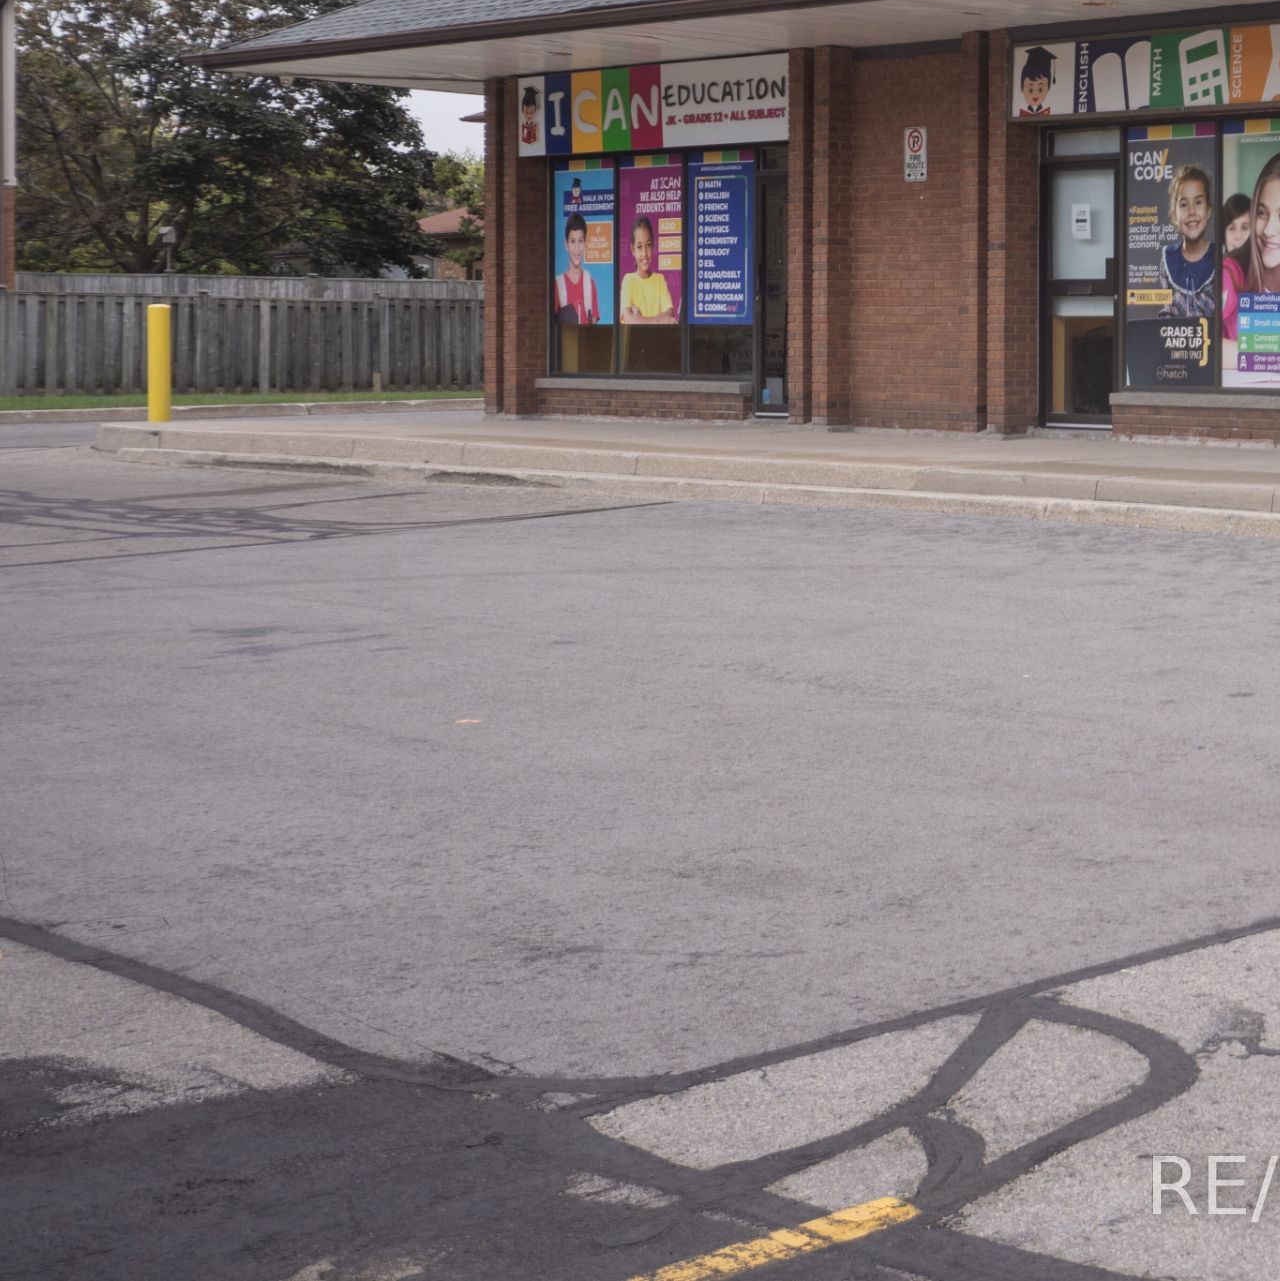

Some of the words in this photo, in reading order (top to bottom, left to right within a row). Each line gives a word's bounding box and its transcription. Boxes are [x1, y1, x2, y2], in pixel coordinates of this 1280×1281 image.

[1232, 32, 1243, 98] SCIENCE
[1152, 48, 1163, 96] MATH
[1079, 43, 1090, 113] ENGLISH
[662, 75, 786, 107] EDUCATION
[666, 115, 677, 126] JK
[683, 113, 712, 125] GRADE
[713, 111, 723, 122] 12
[730, 110, 746, 121] ALL
[747, 107, 786, 120] SUBJECT
[1134, 165, 1173, 180] CODE
[650, 178, 659, 190] AT
[660, 176, 681, 189] ICAN
[705, 180, 721, 188] MATH
[582, 194, 597, 202] WALK
[604, 193, 614, 201] FOR
[639, 191, 649, 202] WE
[650, 191, 665, 201] ALSO
[666, 190, 681, 200] HELP
[705, 192, 730, 200] ENGLISH
[564, 203, 578, 212] FREE
[579, 203, 614, 211] ASSESSMENT
[636, 202, 665, 213] STUDENTS
[665, 202, 681, 212] WITH
[705, 214, 730, 222] SCIENCE
[1129, 216, 1158, 225] growing
[1129, 225, 1149, 233] sector
[1151, 224, 1161, 233] for
[1162, 224, 1174, 234] job
[1129, 233, 1157, 241] creation
[1158, 233, 1165, 241] in
[1129, 241, 1162, 250] economy.
[704, 248, 730, 256] BIOLOGY
[704, 259, 715, 267] ESL
[714, 293, 744, 301] PROGRAM
[704, 303, 727, 311] CODING
[1254, 303, 1278, 312] learning
[1160, 326, 1193, 337] GRADE
[1195, 326, 1202, 337] 3
[1165, 338, 1186, 348] AND
[1188, 337, 1202, 348] UP
[1254, 334, 1279, 343] Concept
[1254, 343, 1278, 351] learning
[1189, 350, 1202, 359] SPACE
[1163, 368, 1187, 379] hatch
